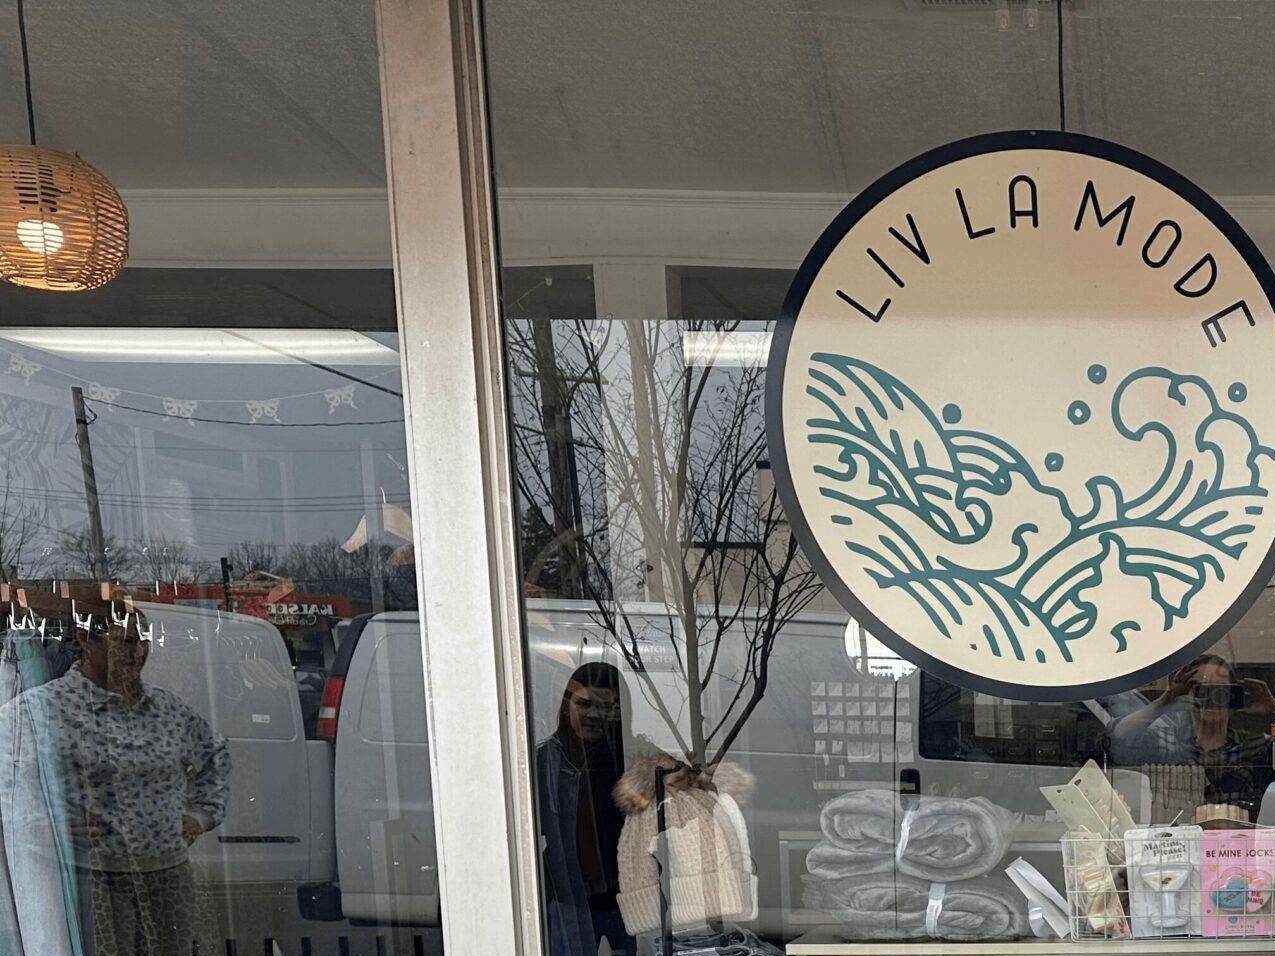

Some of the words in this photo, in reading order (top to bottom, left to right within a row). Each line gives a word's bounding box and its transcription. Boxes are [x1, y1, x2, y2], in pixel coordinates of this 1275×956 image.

[835, 211, 931, 323] LIV
[956, 174, 1040, 239] LA
[1074, 179, 1256, 348] MODE
[636, 645, 666, 653] WATCH
[654, 655, 674, 663] STEP
[1205, 849, 1217, 858] BE
[1218, 849, 1242, 858] MINE
